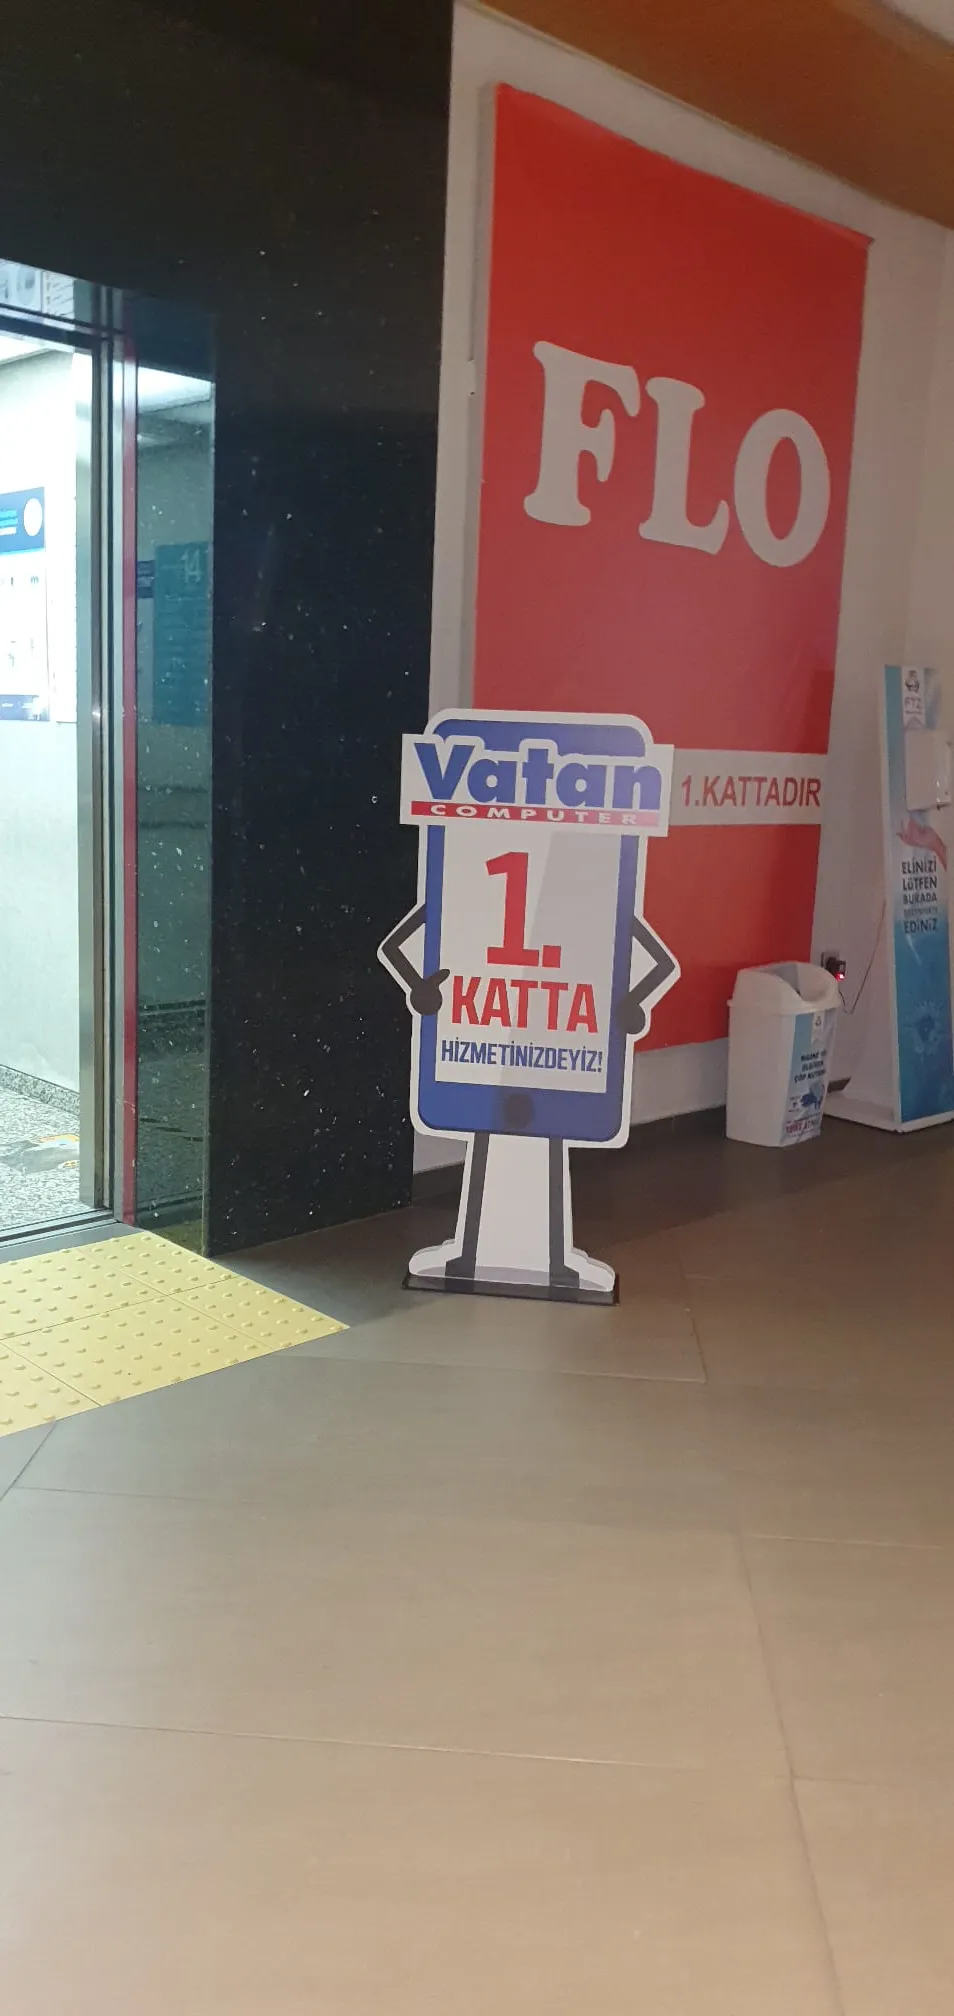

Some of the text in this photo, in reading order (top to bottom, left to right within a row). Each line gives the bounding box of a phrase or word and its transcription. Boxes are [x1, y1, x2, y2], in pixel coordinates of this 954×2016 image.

[524, 340, 831, 567] FLO
[413, 743, 662, 811] Vatan
[681, 775, 820, 808] 1.KATTADIR
[430, 804, 638, 825] COMPUTER
[903, 876, 937, 890] LÜTFEN
[485, 851, 561, 968] 1.
[451, 975, 598, 1034] KATTA
[441, 1037, 603, 1073] HİZMETİNİZDEYİZ!
